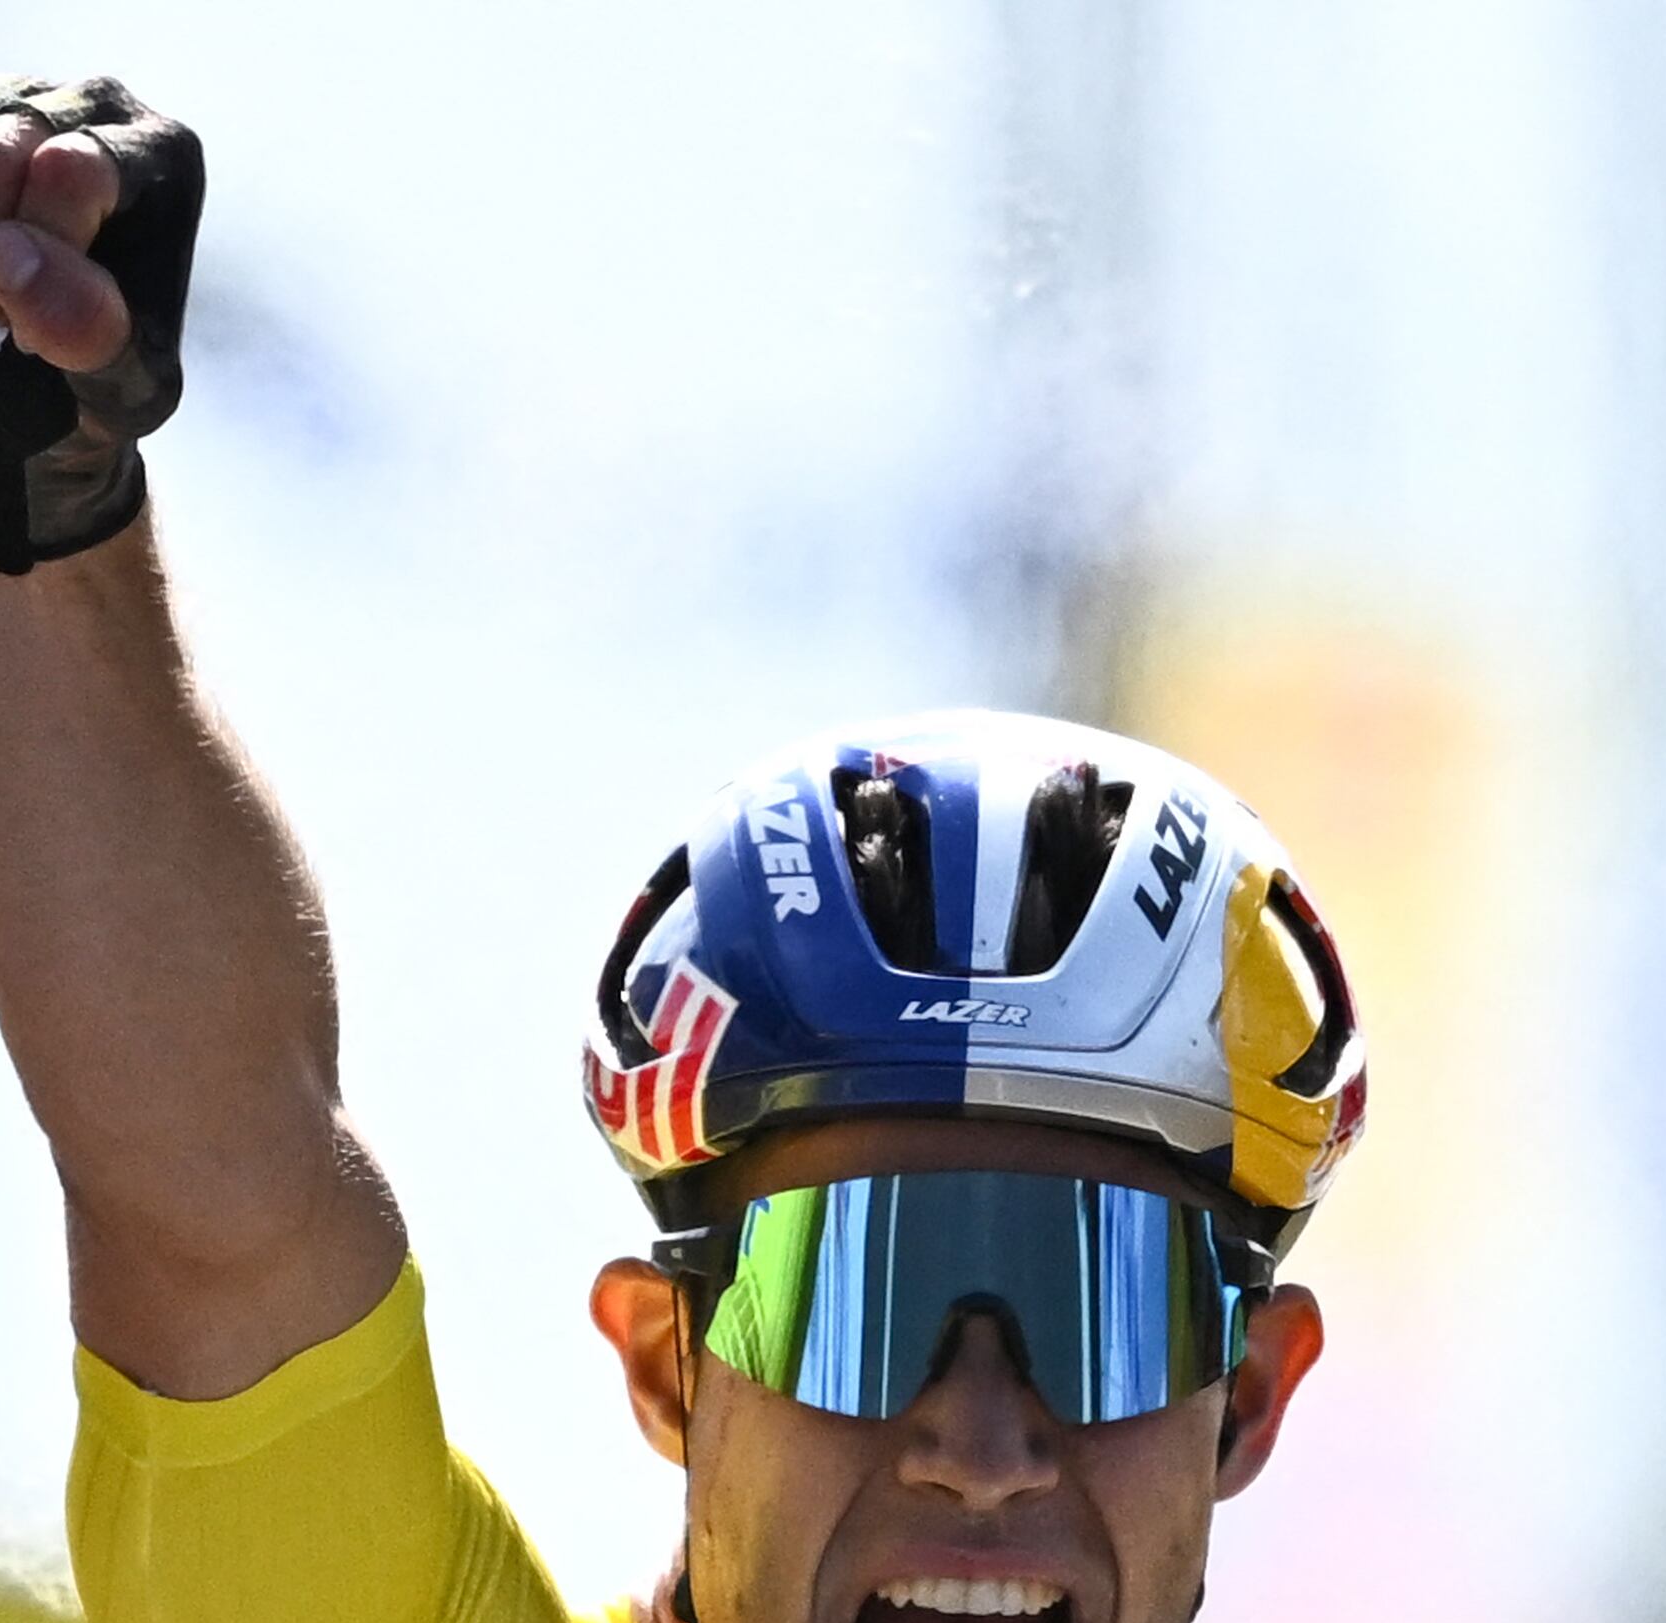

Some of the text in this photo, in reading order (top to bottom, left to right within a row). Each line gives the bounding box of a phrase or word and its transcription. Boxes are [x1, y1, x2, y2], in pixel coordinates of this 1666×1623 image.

[746, 782, 821, 923] AZER
[1134, 787, 1208, 942] LAZE
[898, 999, 1031, 1027] LAZER
